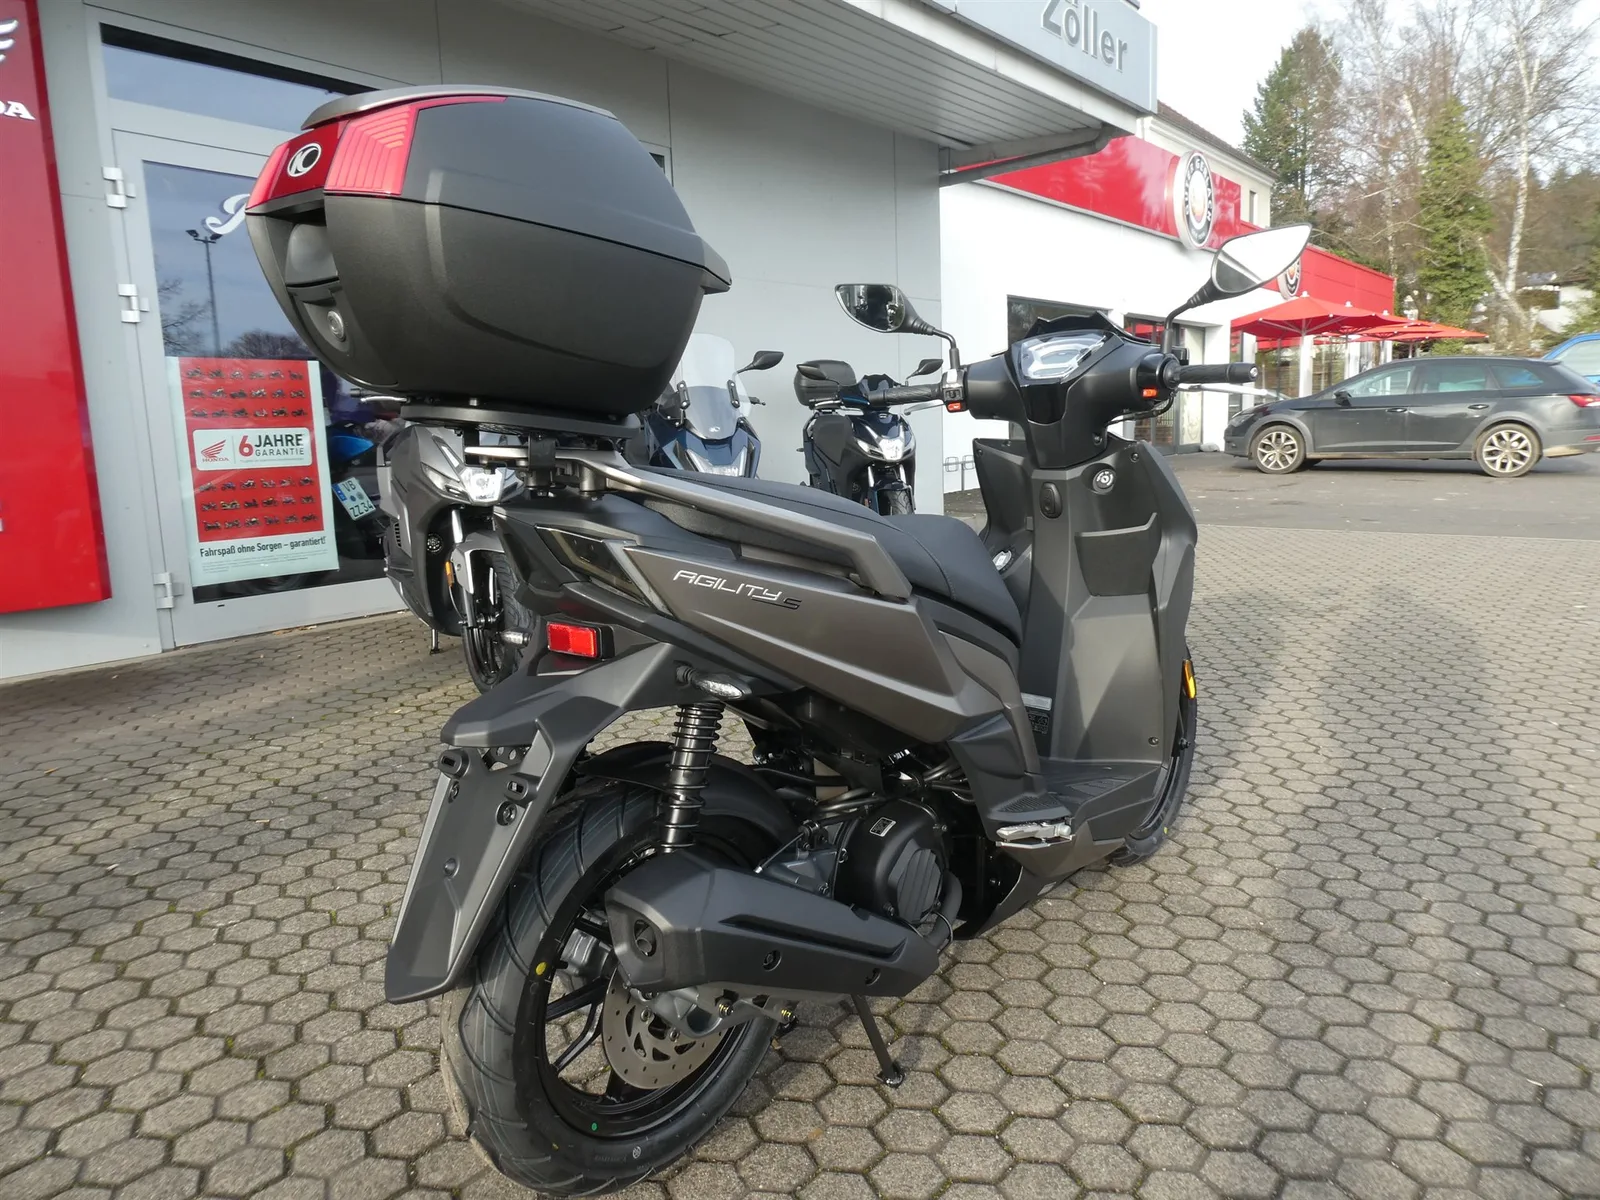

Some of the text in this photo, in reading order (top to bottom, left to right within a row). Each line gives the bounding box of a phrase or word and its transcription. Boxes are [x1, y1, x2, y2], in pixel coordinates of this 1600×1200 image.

[1040, 0, 1128, 73] Zöller
[239, 433, 304, 457] 6 JAHRE
[255, 447, 305, 457] GARANTIE
[342, 480, 357, 492] VB
[200, 545, 236, 558] Fahrspaß
[237, 544, 256, 554] ohne
[256, 541, 283, 552] Sorgen
[673, 569, 783, 601] AGILITY
